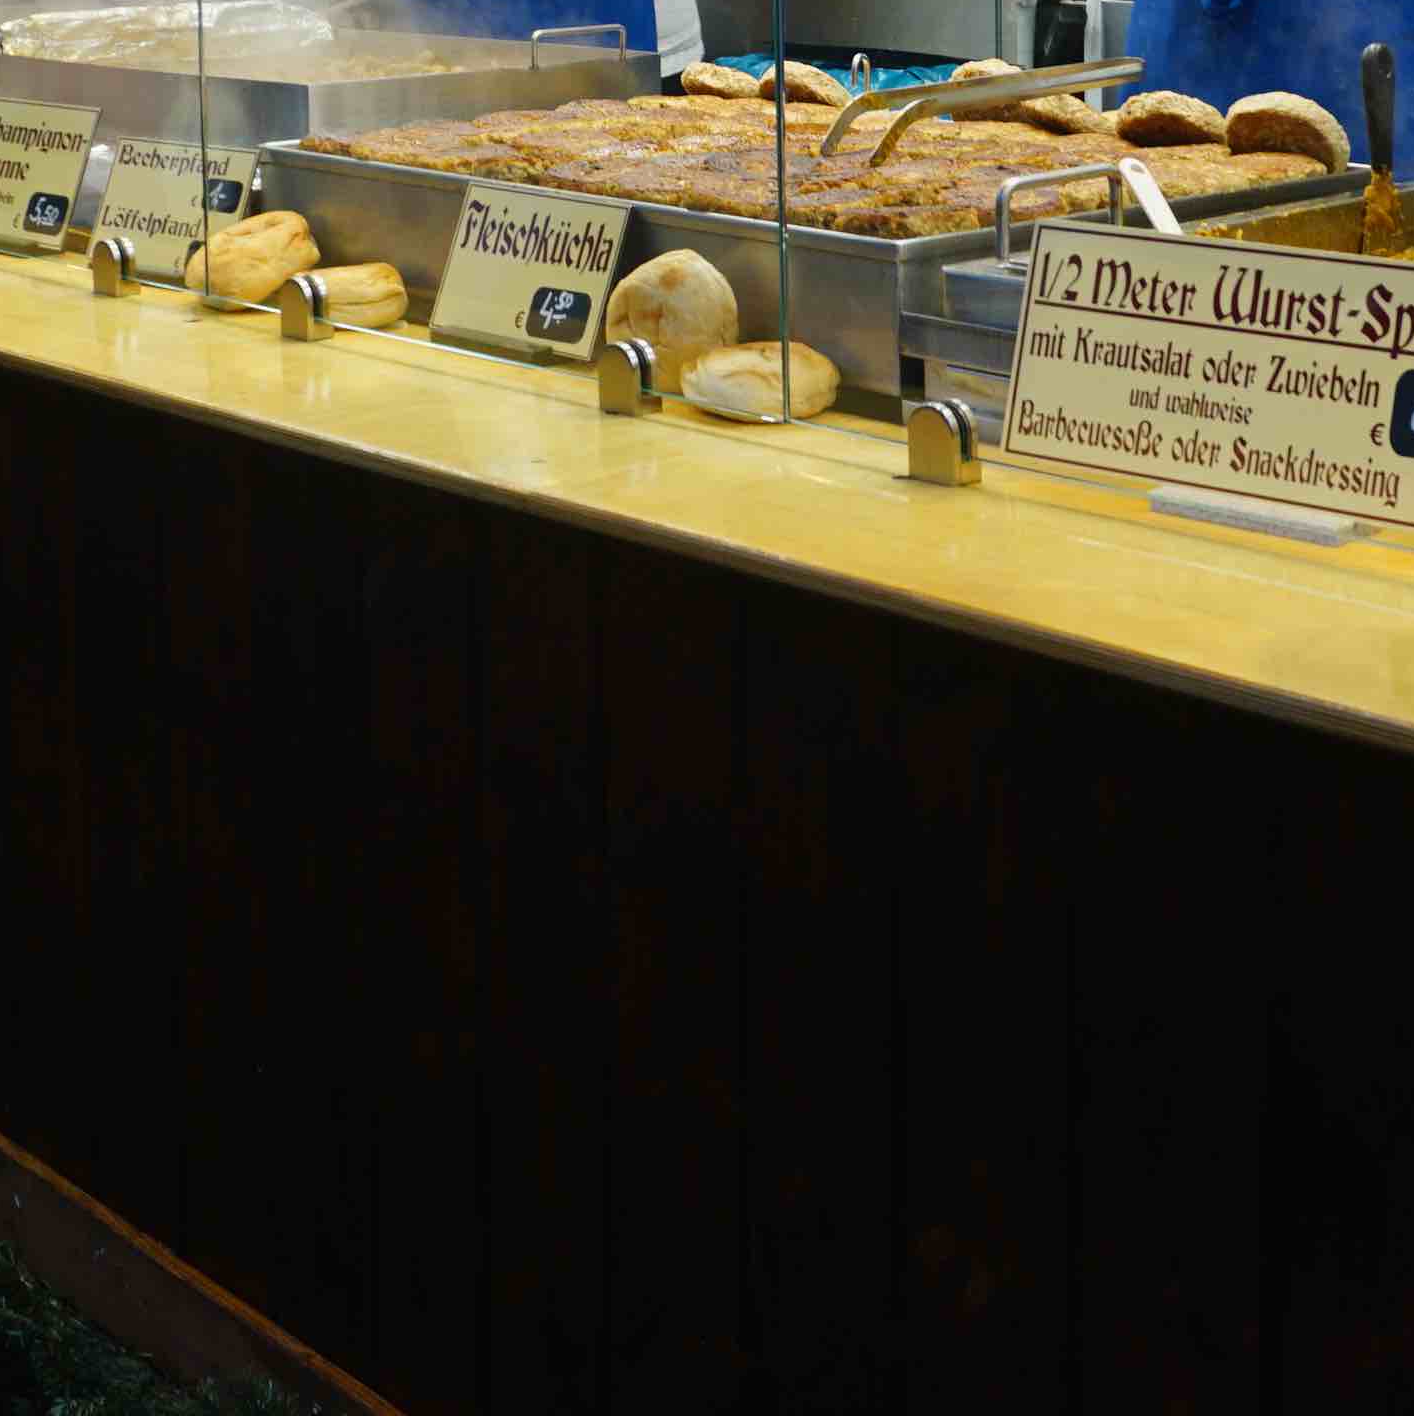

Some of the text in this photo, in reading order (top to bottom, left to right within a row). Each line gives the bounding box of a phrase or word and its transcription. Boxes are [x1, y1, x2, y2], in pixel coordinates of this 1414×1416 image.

[118, 143, 230, 177] Becherpfand
[101, 205, 202, 239] Löffelpfand
[460, 199, 614, 275] Fleischküchla
[1039, 252, 1083, 303] 1/2
[1091, 256, 1196, 317] Meter
[1030, 325, 1381, 408] mit Krautsalat oder Zwiebeln
[1129, 386, 1254, 426] und wahlweise
[1017, 400, 1401, 508] Barbecuesoße oder Snackdressing
[1369, 423, 1385, 446] €
